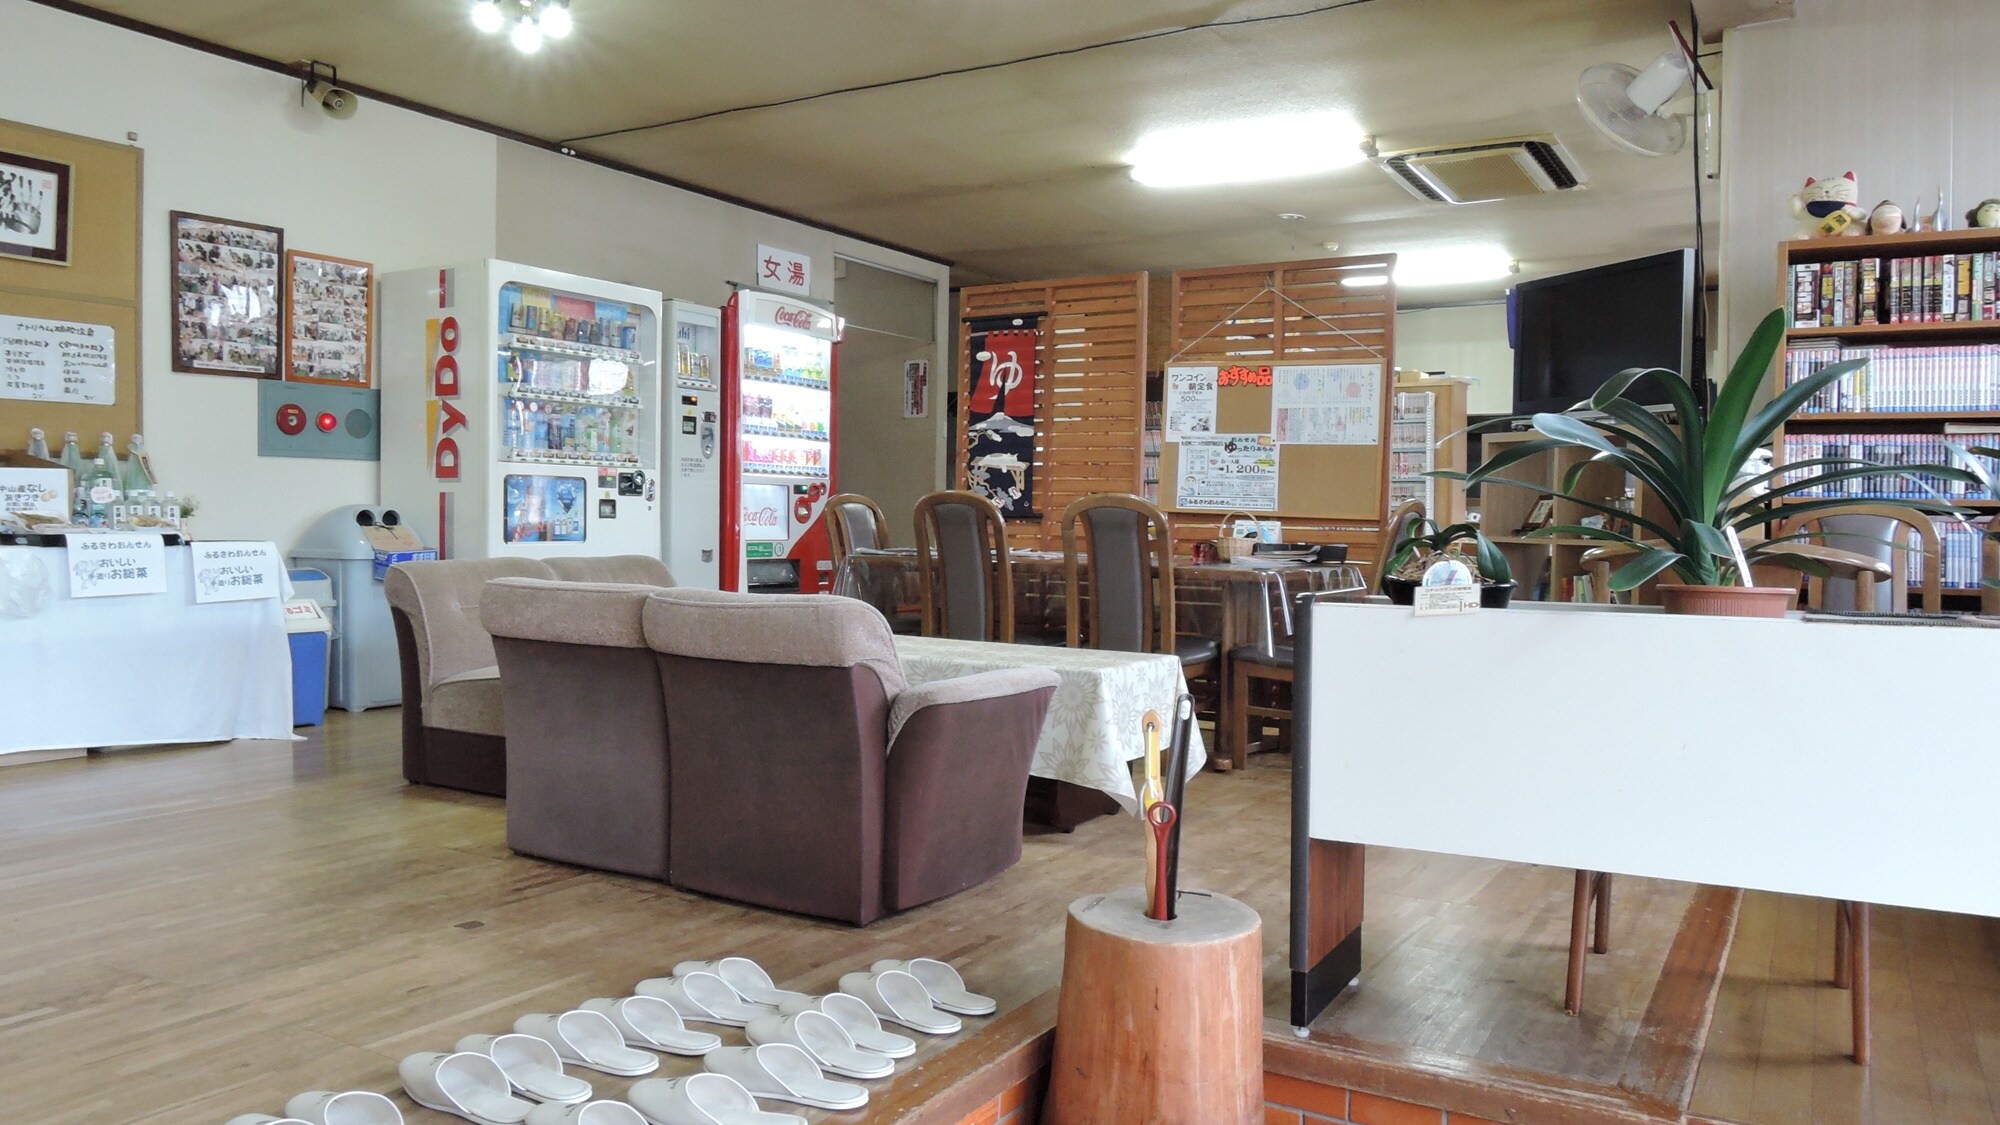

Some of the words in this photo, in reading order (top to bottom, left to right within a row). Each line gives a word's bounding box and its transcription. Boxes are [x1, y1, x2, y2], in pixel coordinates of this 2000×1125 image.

[763, 255, 805, 286] 女湯
[988, 350, 1023, 400] ゆ
[1171, 373, 1207, 382] ワンコイン
[1218, 365, 1273, 387] おすすめ品
[81, 541, 152, 550] ふるさわおんせん
[204, 549, 267, 559] ふるさわおんせん
[99, 558, 137, 568] おいしい
[219, 565, 253, 575] おいしい
